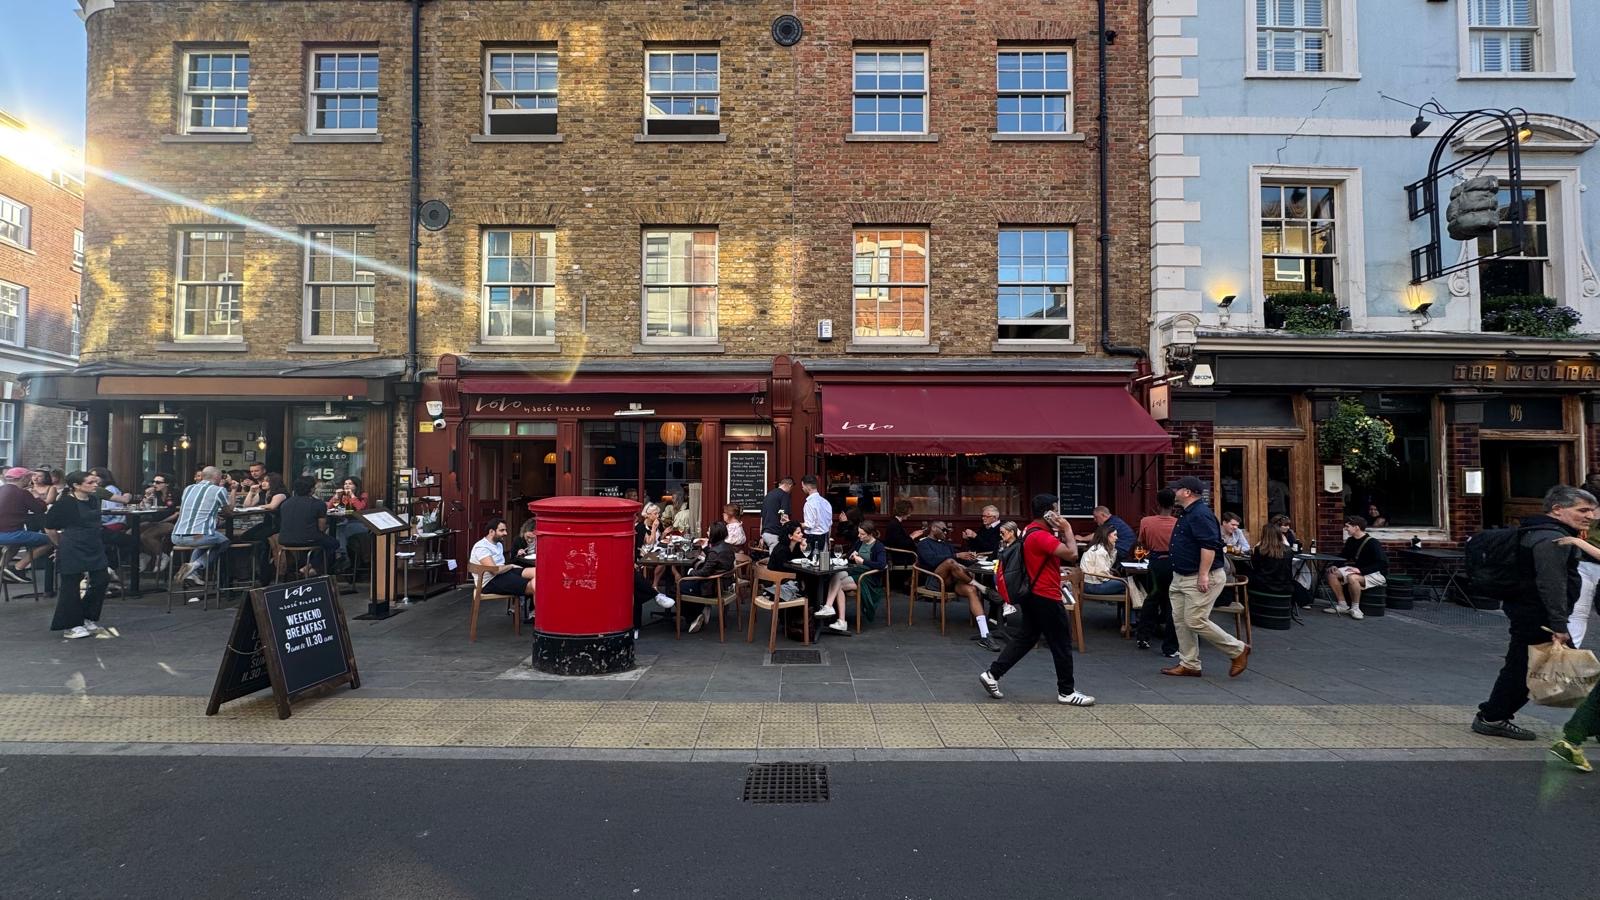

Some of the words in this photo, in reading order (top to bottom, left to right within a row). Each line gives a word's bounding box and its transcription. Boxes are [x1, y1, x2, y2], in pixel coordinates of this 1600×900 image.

[1454, 364, 1497, 380] THE
[1505, 365, 1600, 380] WOOLPA
[314, 468, 335, 480] 15
[286, 608, 322, 626] WEEKEND
[285, 619, 327, 640] BREAKFAST
[305, 633, 324, 648] 11.30
